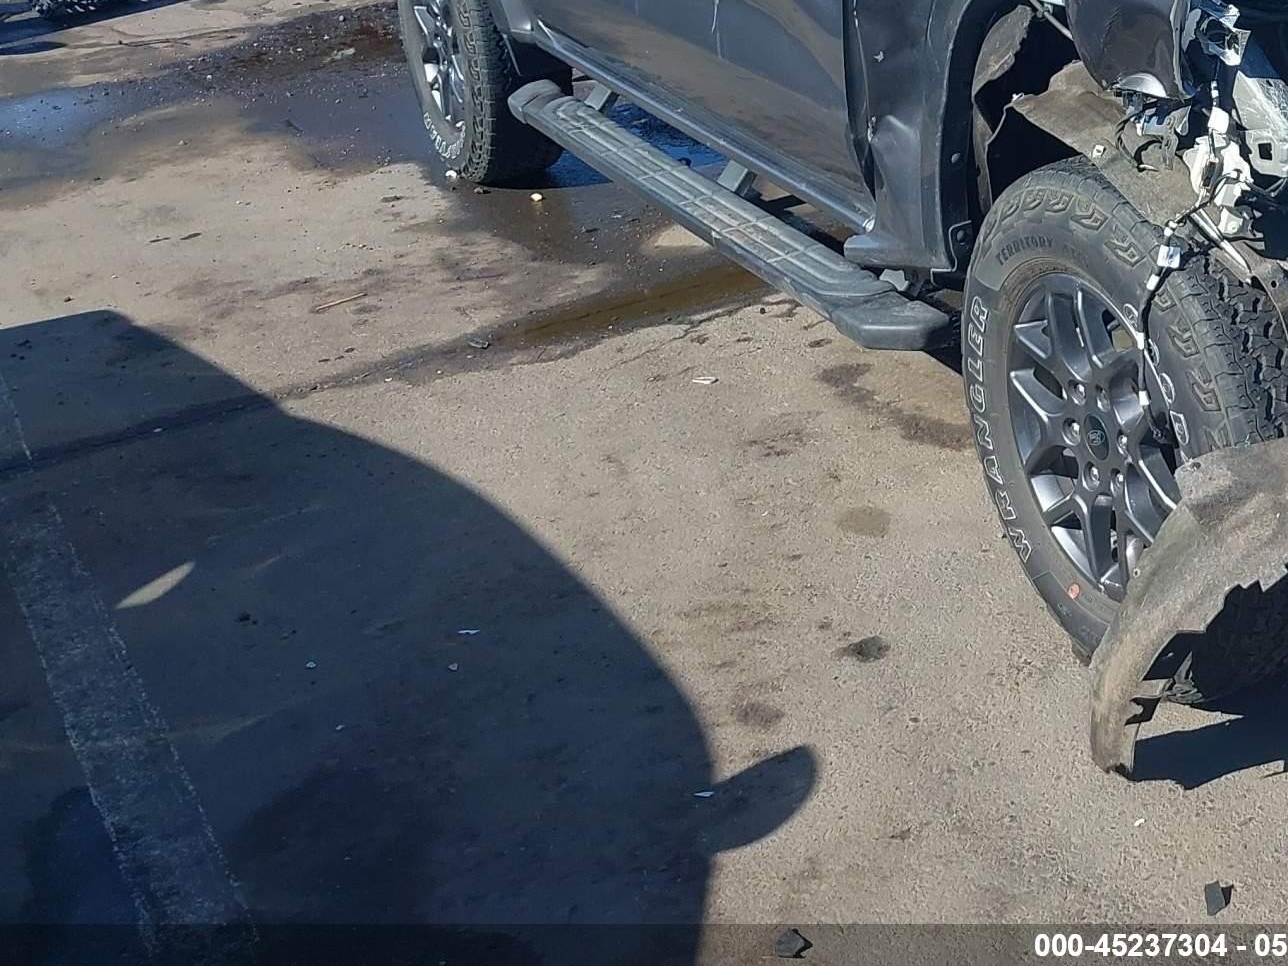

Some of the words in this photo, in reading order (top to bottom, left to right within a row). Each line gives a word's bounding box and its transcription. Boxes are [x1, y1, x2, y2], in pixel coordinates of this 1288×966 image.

[995, 234, 1054, 266] TERRITORY
[967, 295, 1033, 564] WRANGLER
[1122, 303, 1191, 447] GOOD
